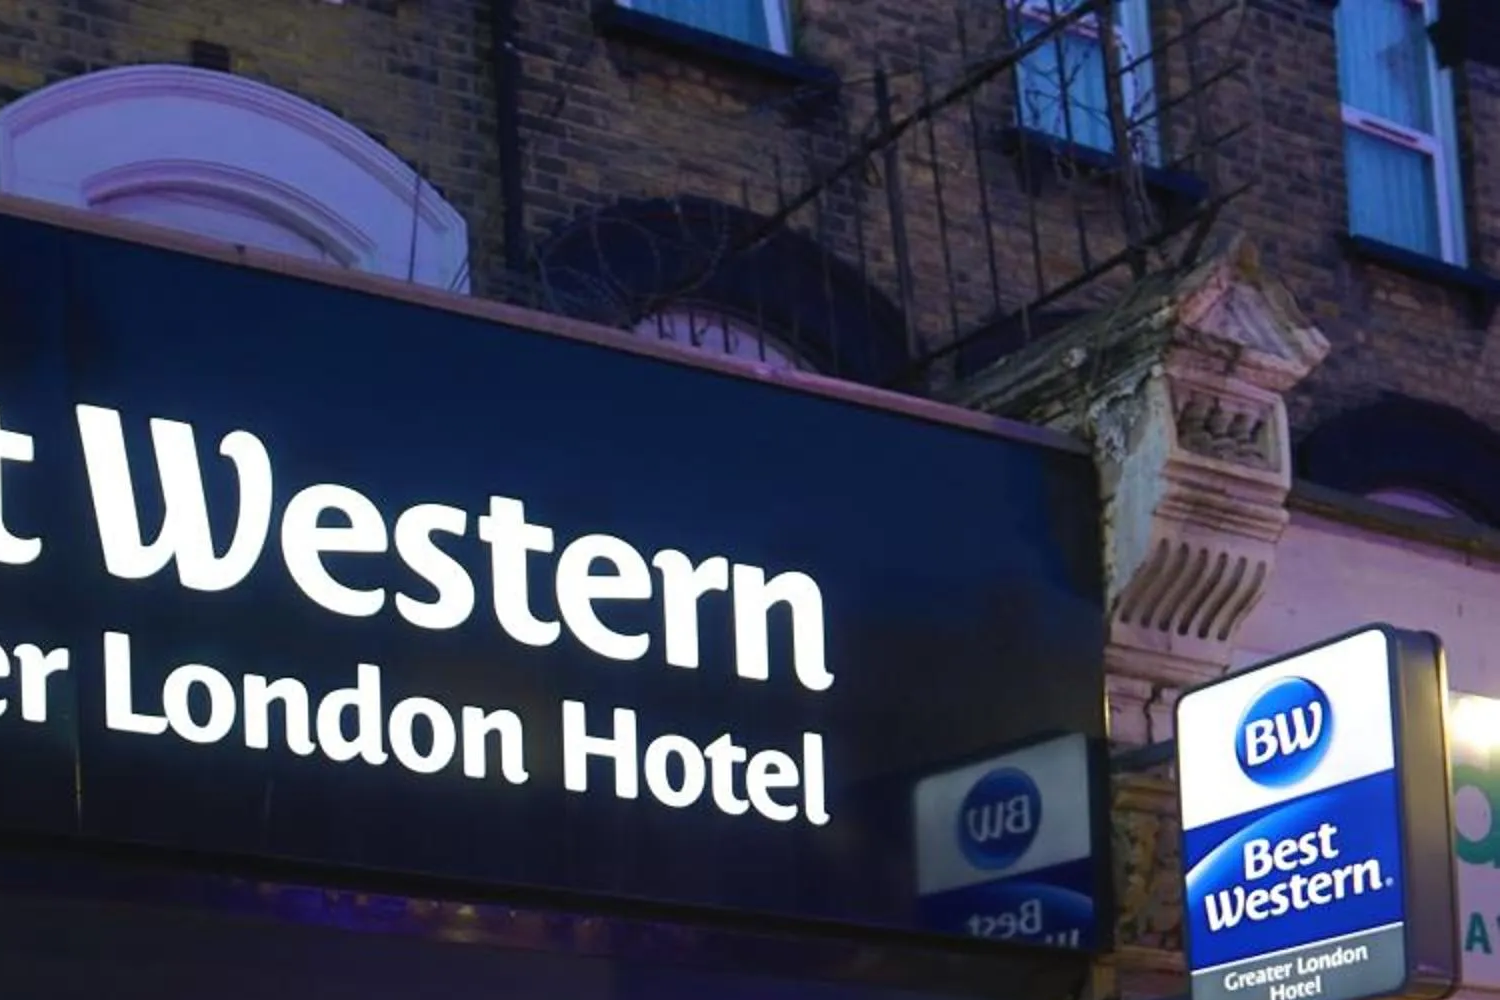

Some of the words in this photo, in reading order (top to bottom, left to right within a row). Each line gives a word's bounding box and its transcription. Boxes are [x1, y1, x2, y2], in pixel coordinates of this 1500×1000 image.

[76, 403, 835, 691] Western
[103, 631, 529, 785] London
[563, 699, 830, 826] Hotel
[1243, 700, 1323, 768] BW
[1242, 822, 1339, 882] Best
[1203, 858, 1385, 932] Western
[1224, 962, 1293, 993] Greater
[1296, 943, 1368, 974] London
